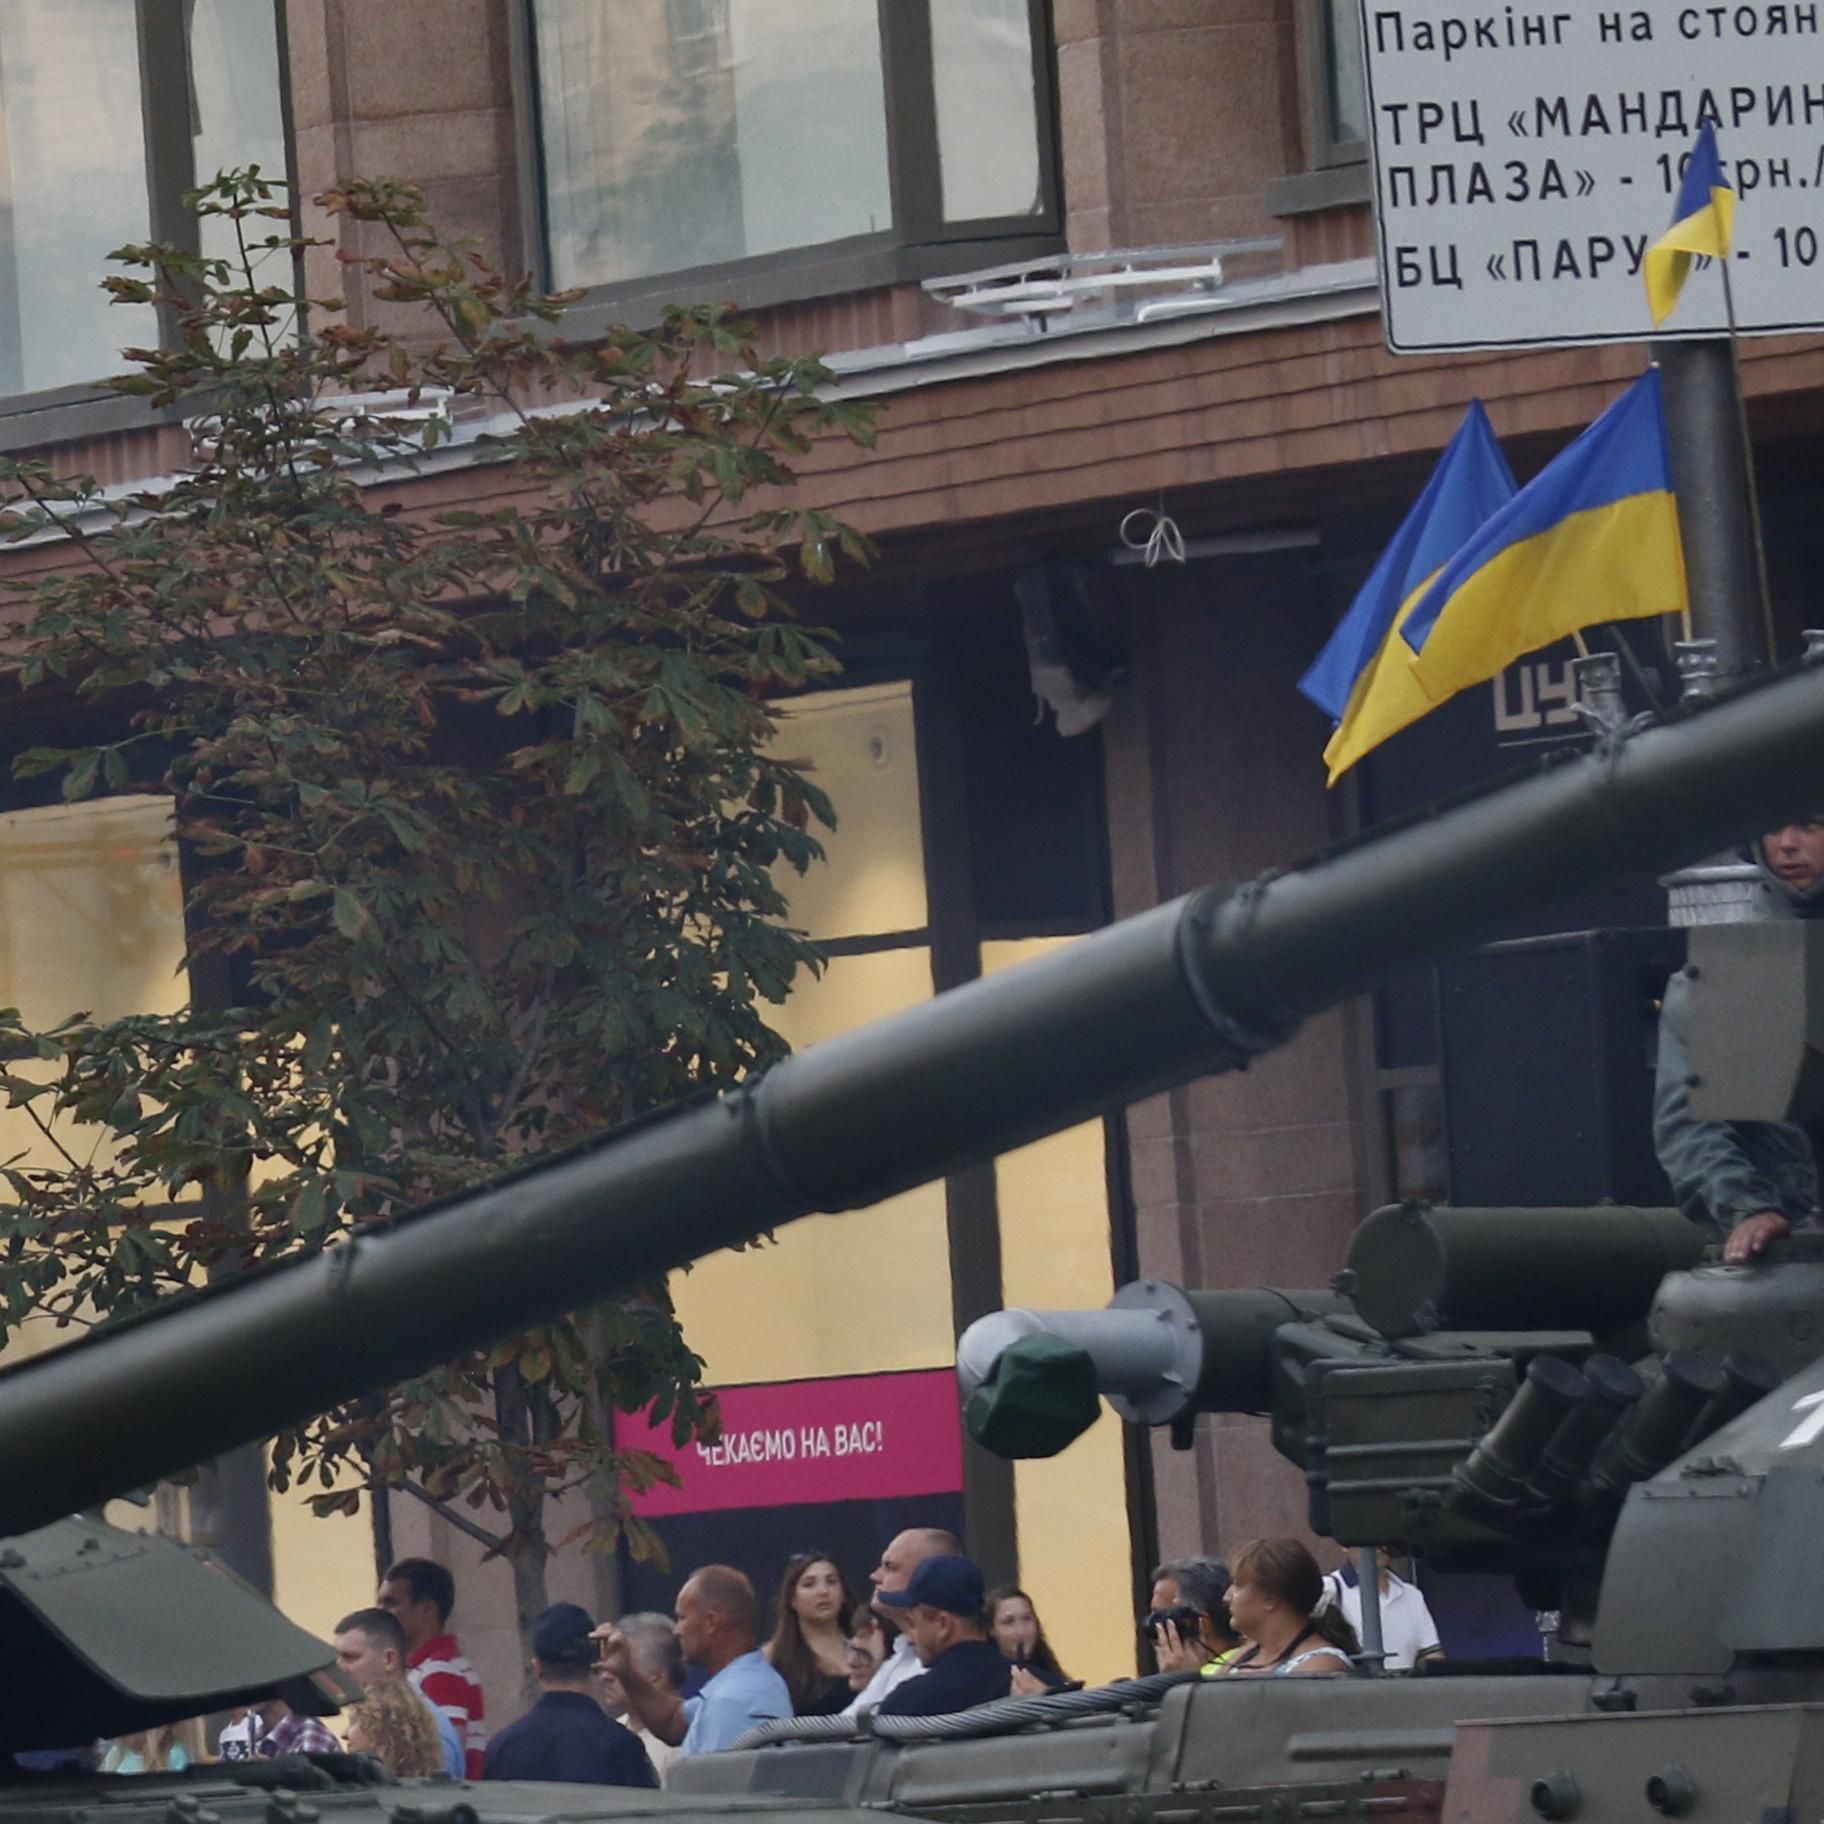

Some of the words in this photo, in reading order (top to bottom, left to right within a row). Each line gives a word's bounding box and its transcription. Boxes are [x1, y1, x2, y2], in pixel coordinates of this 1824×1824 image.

[1374, 6, 1571, 61] Паркінг
[1599, 10, 1653, 43] на
[1678, 3, 1817, 39] стоян
[1382, 100, 1485, 147] ТРЦ
[1388, 158, 1595, 208] ПЛАЗА»
[1396, 244, 1463, 290] БЦ
[1486, 233, 1713, 283] «ПАРУ»
[1773, 225, 1818, 268] 10
[1492, 658, 1620, 732] ЦУ
[696, 1428, 796, 1467] ЧЕКАЄМО
[801, 1426, 831, 1459] НА
[834, 1420, 884, 1456] ВАС!
